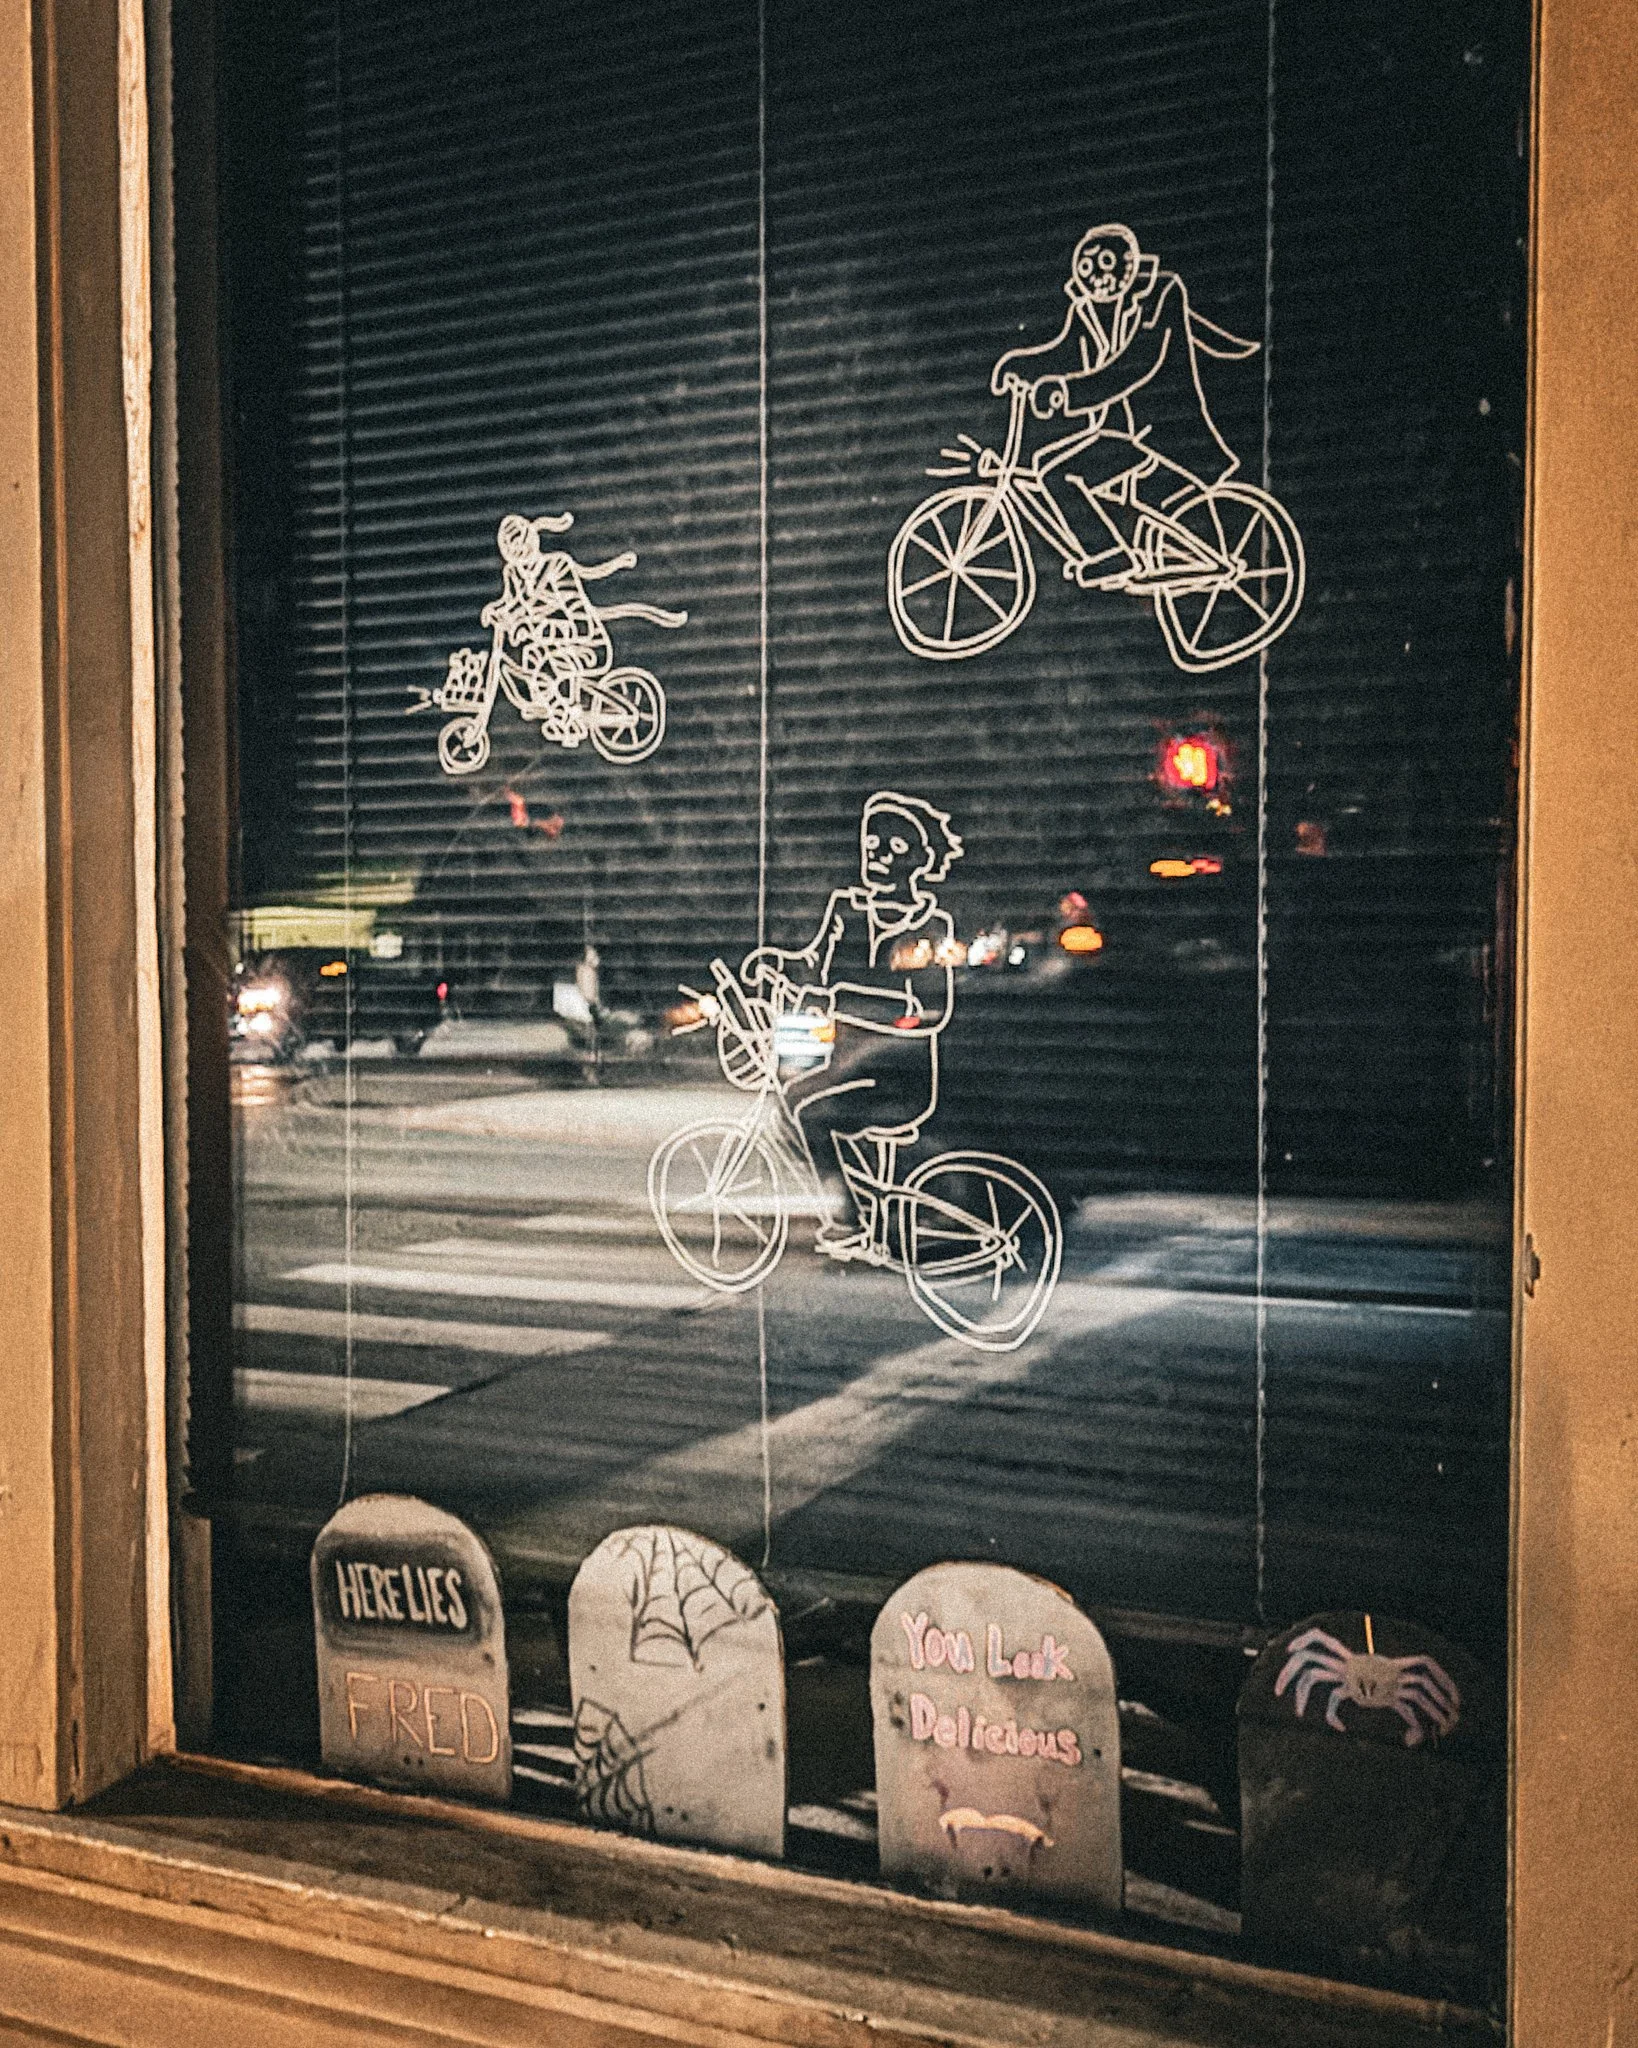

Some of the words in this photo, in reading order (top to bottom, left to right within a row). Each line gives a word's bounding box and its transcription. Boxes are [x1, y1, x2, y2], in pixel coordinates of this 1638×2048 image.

[335, 1560, 404, 1620] HERE
[402, 1563, 468, 1630] LIES
[901, 1611, 975, 1674] You
[986, 1622, 1075, 1681] Look
[345, 1671, 500, 1764] FRED
[910, 1692, 1083, 1767] Delicious
